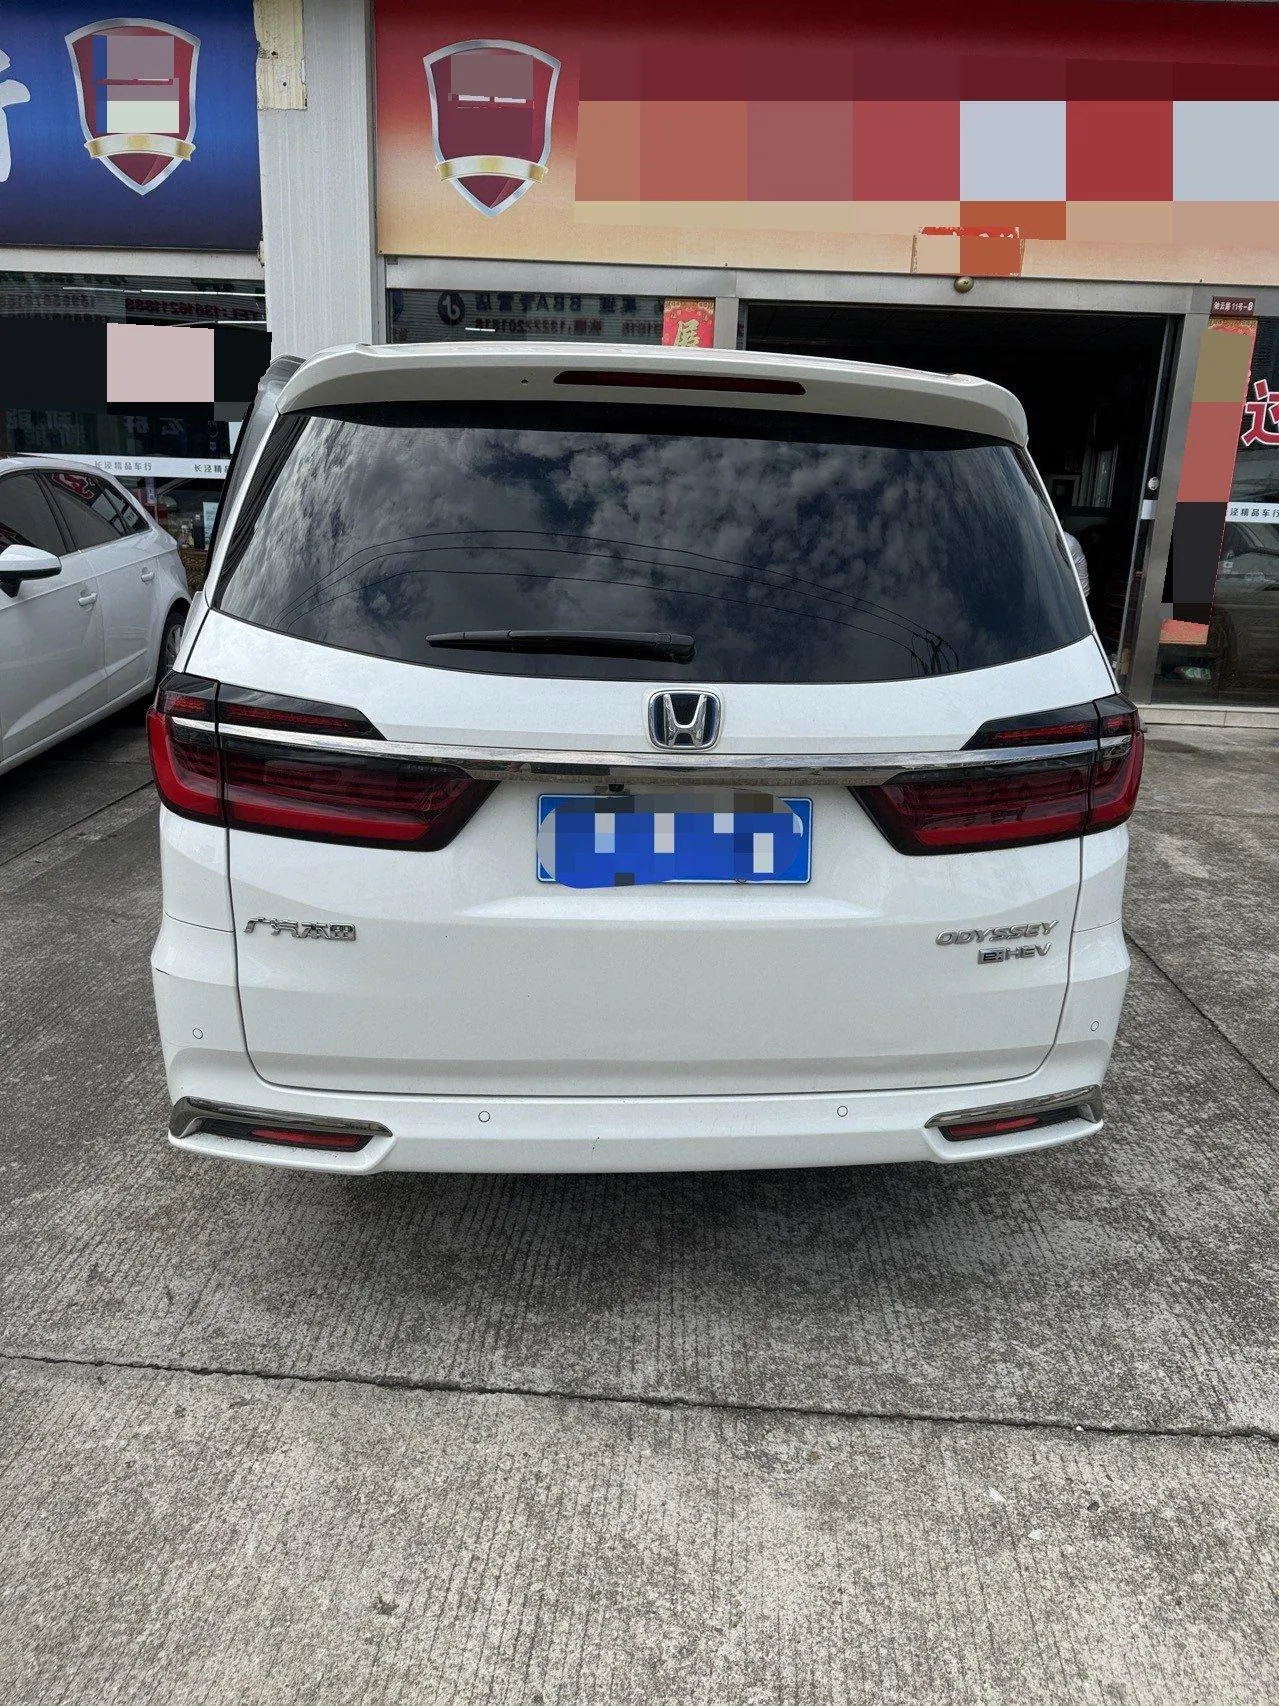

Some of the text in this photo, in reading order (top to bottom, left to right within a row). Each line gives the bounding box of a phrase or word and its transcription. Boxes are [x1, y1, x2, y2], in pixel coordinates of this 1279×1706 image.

[243, 917, 357, 942] 广汽本田
[935, 920, 1060, 946] ODYSSEY
